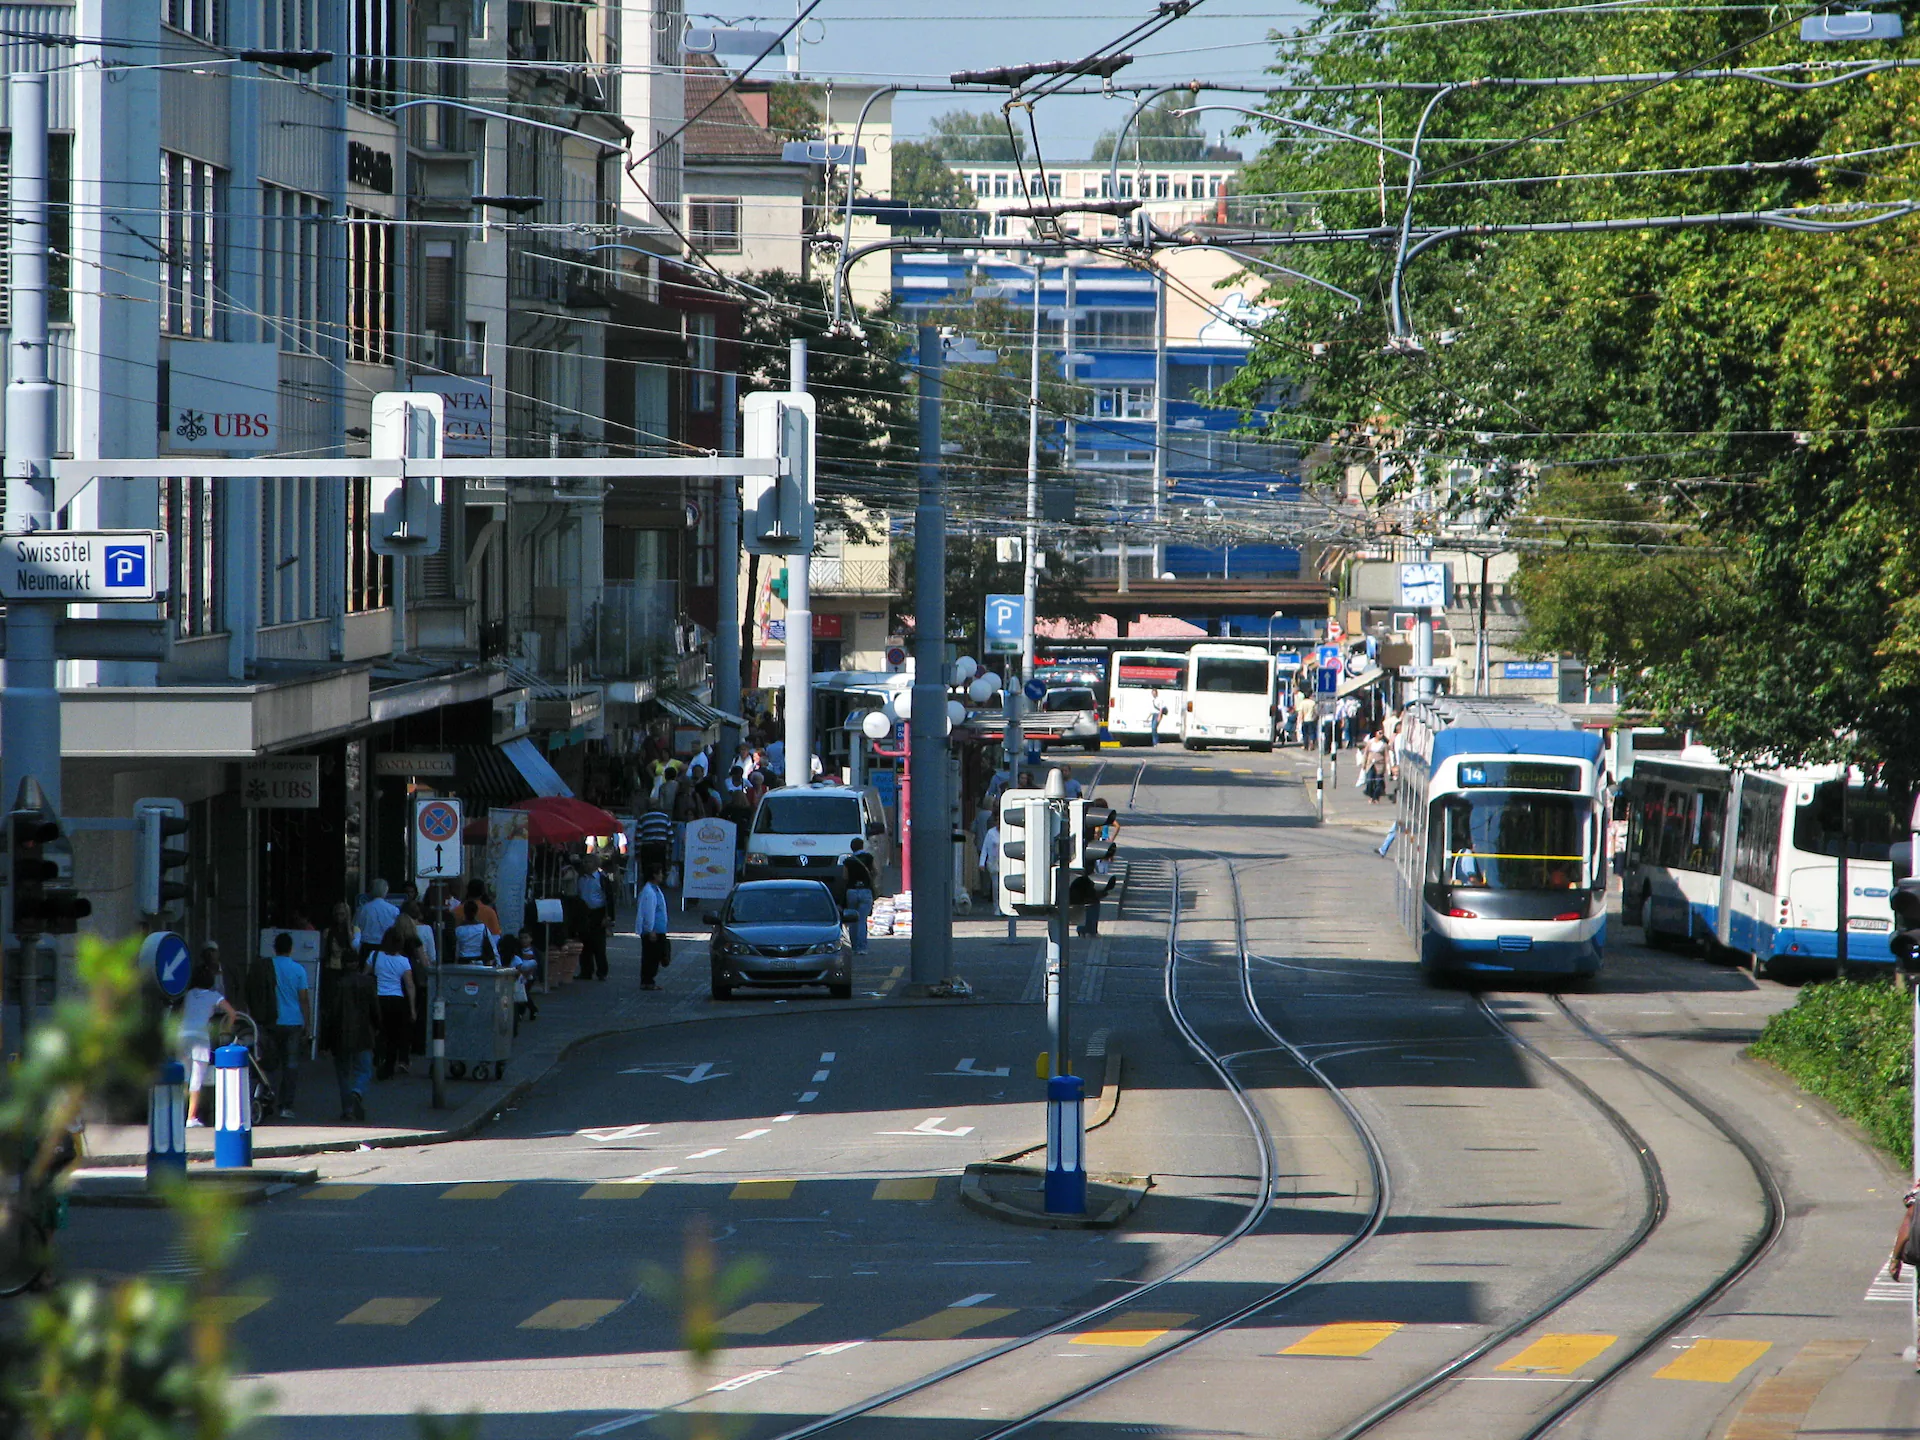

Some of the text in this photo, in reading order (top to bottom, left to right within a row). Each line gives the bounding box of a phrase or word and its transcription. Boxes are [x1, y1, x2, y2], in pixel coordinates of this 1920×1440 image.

[442, 393, 488, 409] NTA
[214, 413, 269, 437] UBS
[445, 422, 488, 440] CIA
[17, 540, 91, 562] Swissôtel
[17, 569, 90, 590] Neumarkt
[117, 558, 133, 582] P
[377, 760, 452, 770] SANTA LUCIA
[1465, 768, 1483, 780] 14
[272, 780, 312, 799] UBS
